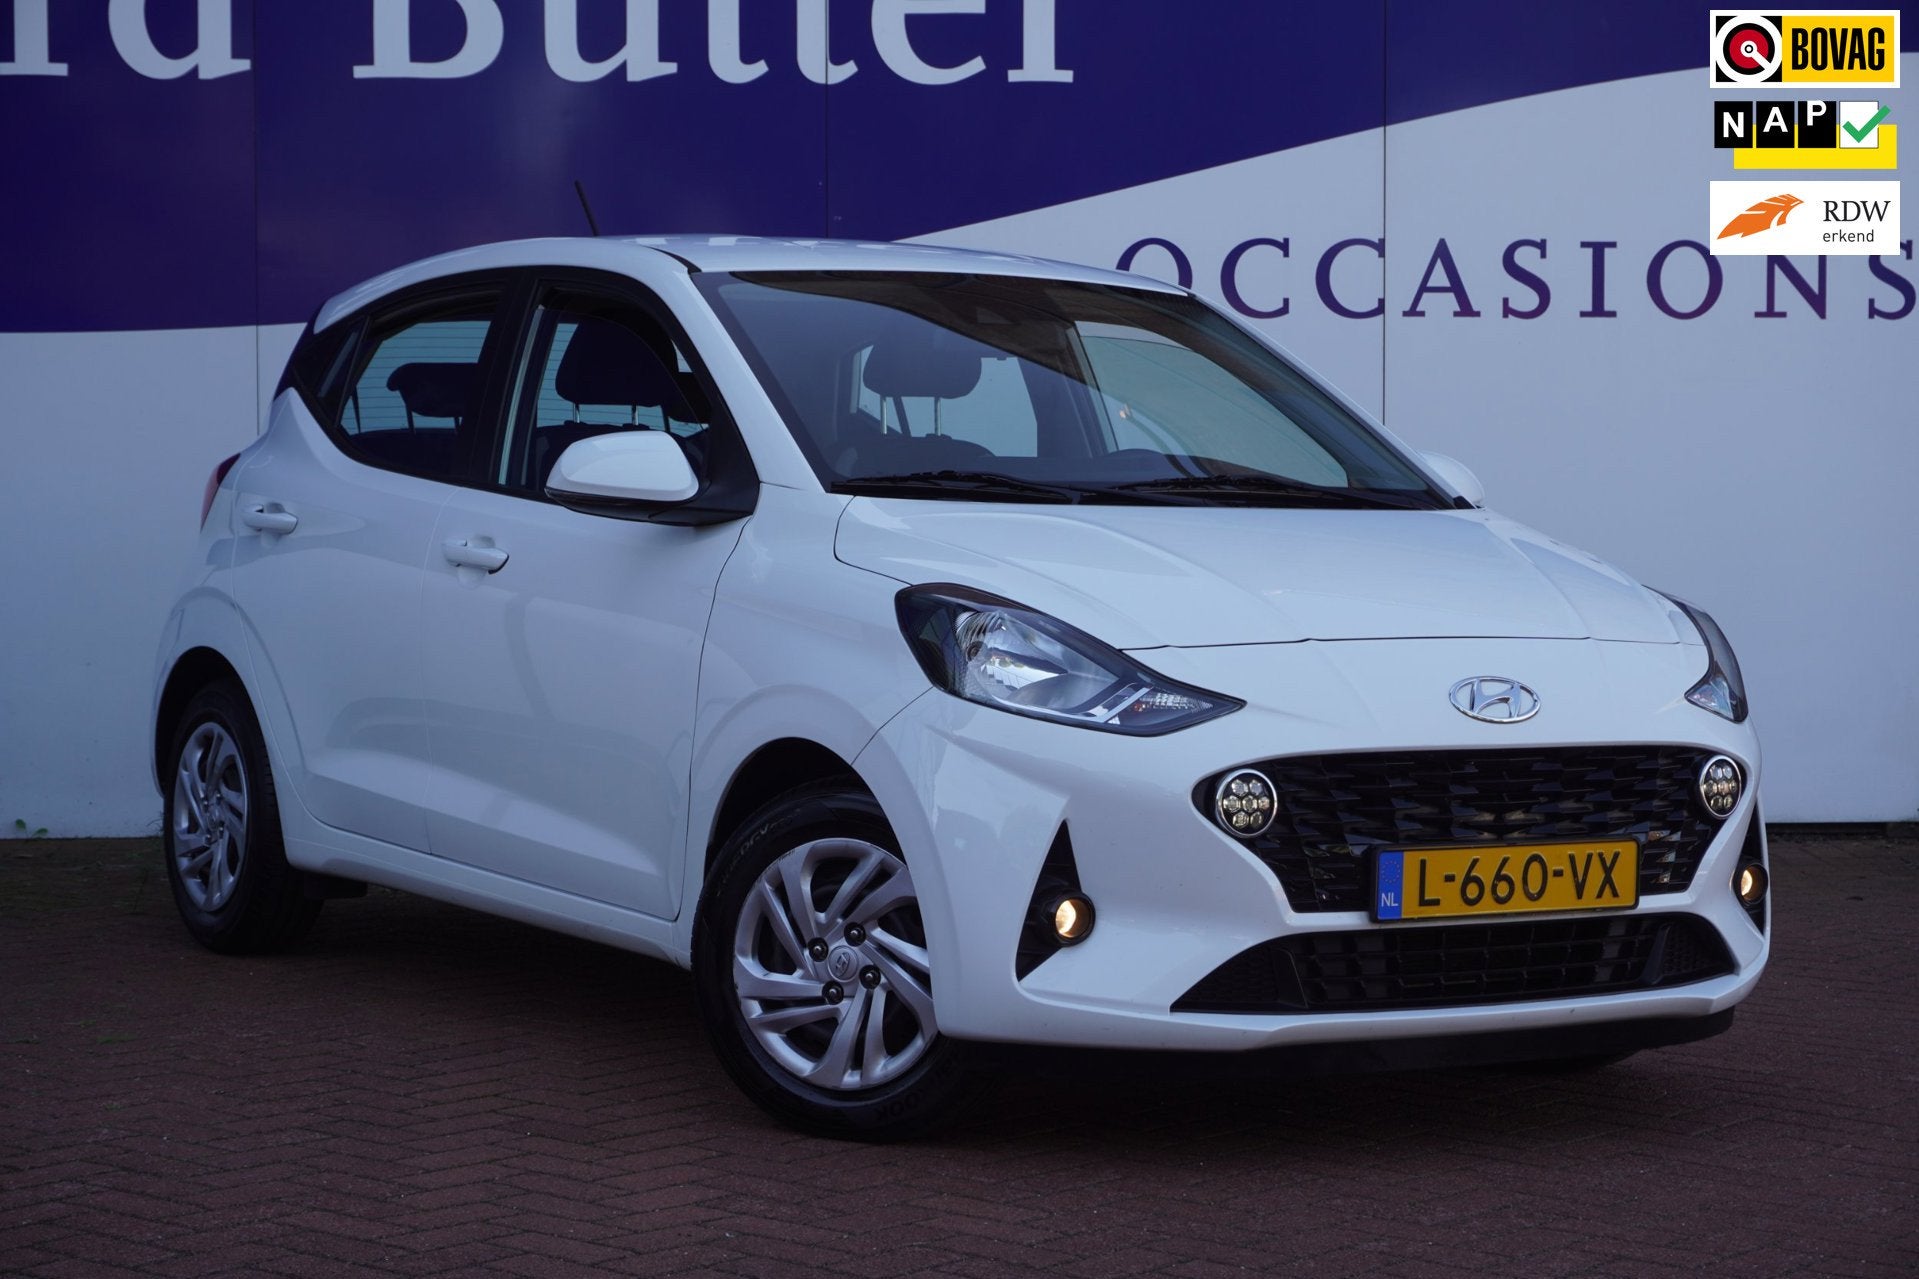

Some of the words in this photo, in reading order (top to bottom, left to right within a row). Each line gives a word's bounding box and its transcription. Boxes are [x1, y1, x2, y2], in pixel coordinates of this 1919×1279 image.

[1115, 237, 1917, 320] OCCASIONS
[1381, 892, 1399, 908] NL
[1418, 851, 1621, 907] L-660-VX
